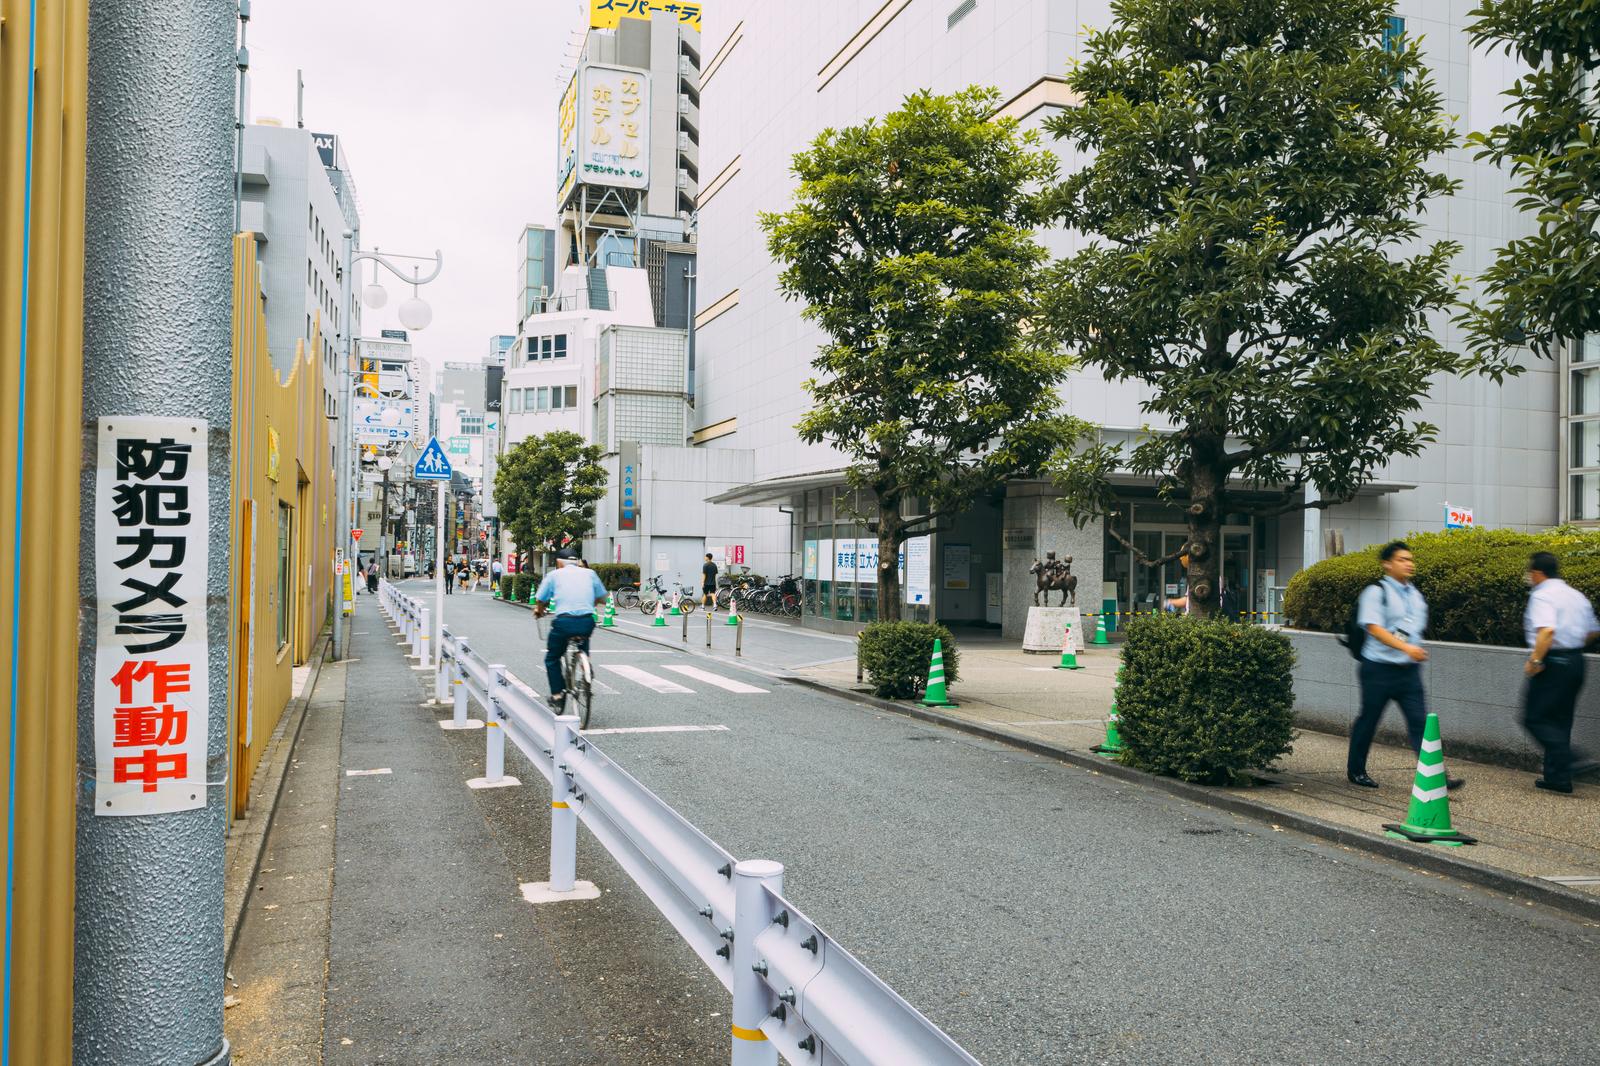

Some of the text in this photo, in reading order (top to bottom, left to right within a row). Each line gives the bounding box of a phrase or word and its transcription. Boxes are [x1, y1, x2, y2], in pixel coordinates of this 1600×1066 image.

[597, 0, 702, 23] スーパーホテ
[591, 84, 612, 145] ホテル
[837, 552, 904, 570] 東京都立大久院
[111, 437, 192, 793] 防犯カメラ作動中
